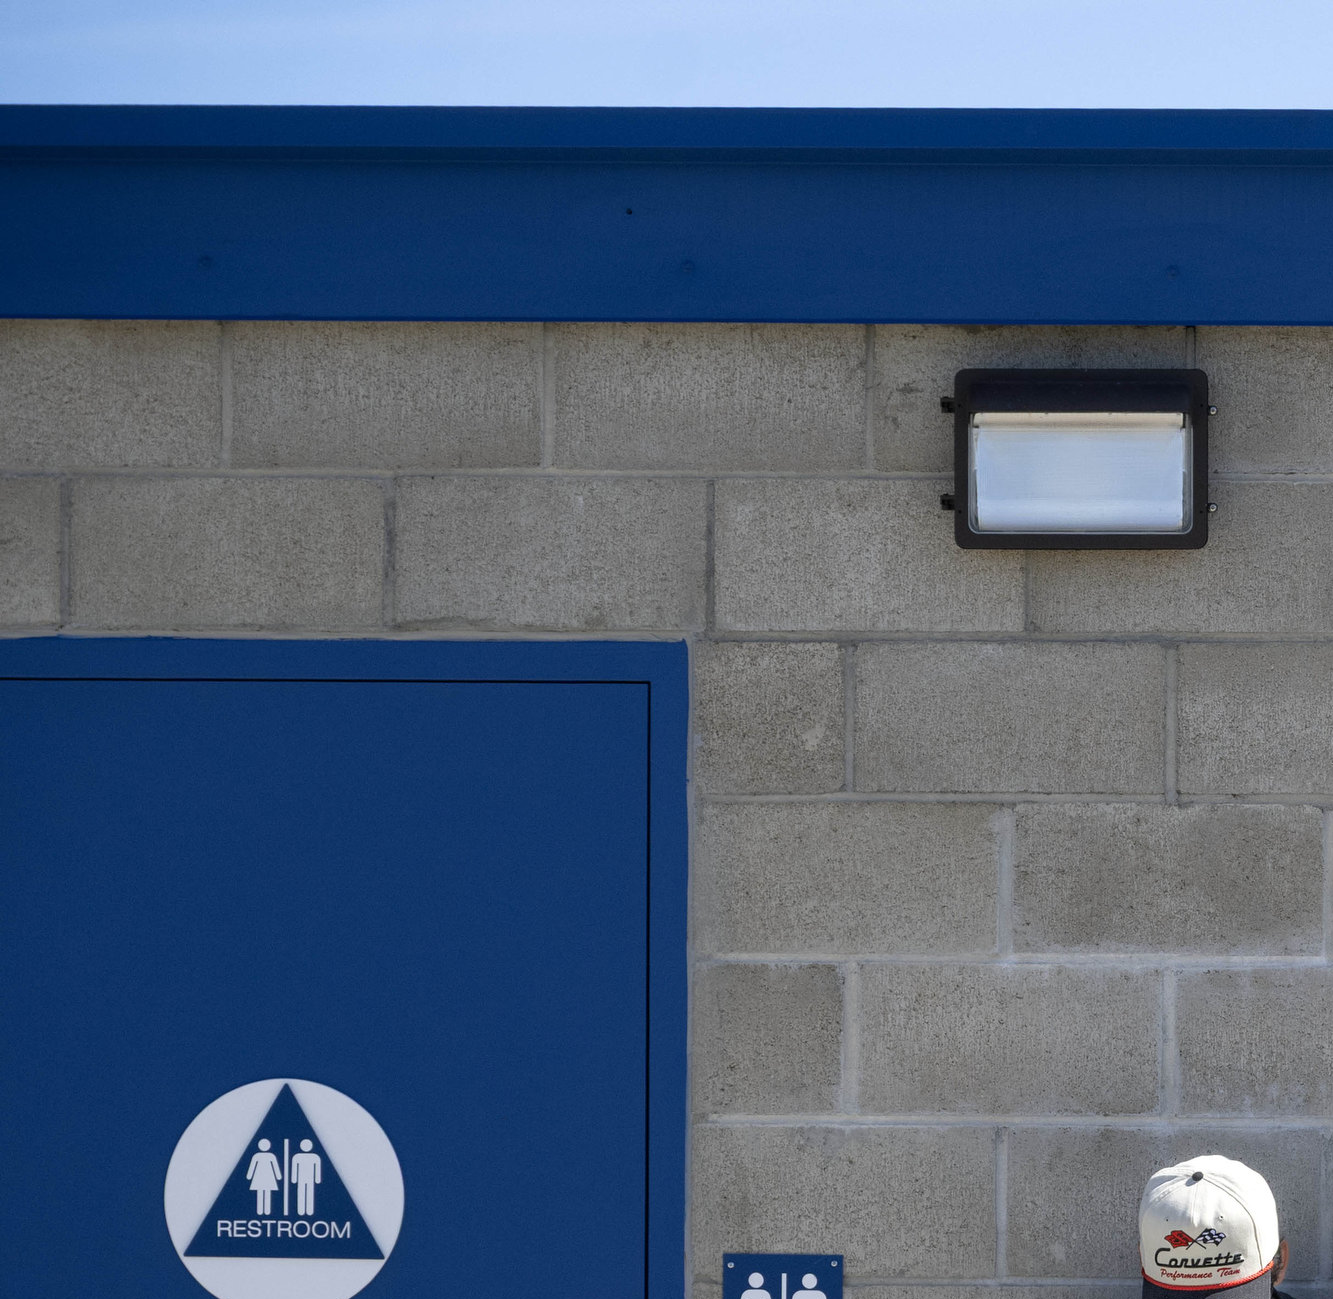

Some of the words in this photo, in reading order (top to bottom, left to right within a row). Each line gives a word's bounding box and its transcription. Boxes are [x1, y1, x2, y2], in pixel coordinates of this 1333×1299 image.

[217, 1220, 351, 1239] RESTROOM
[1154, 1247, 1244, 1268] Corvette
[1160, 1268, 1213, 1281] Performance
[1217, 1267, 1241, 1277] Team
